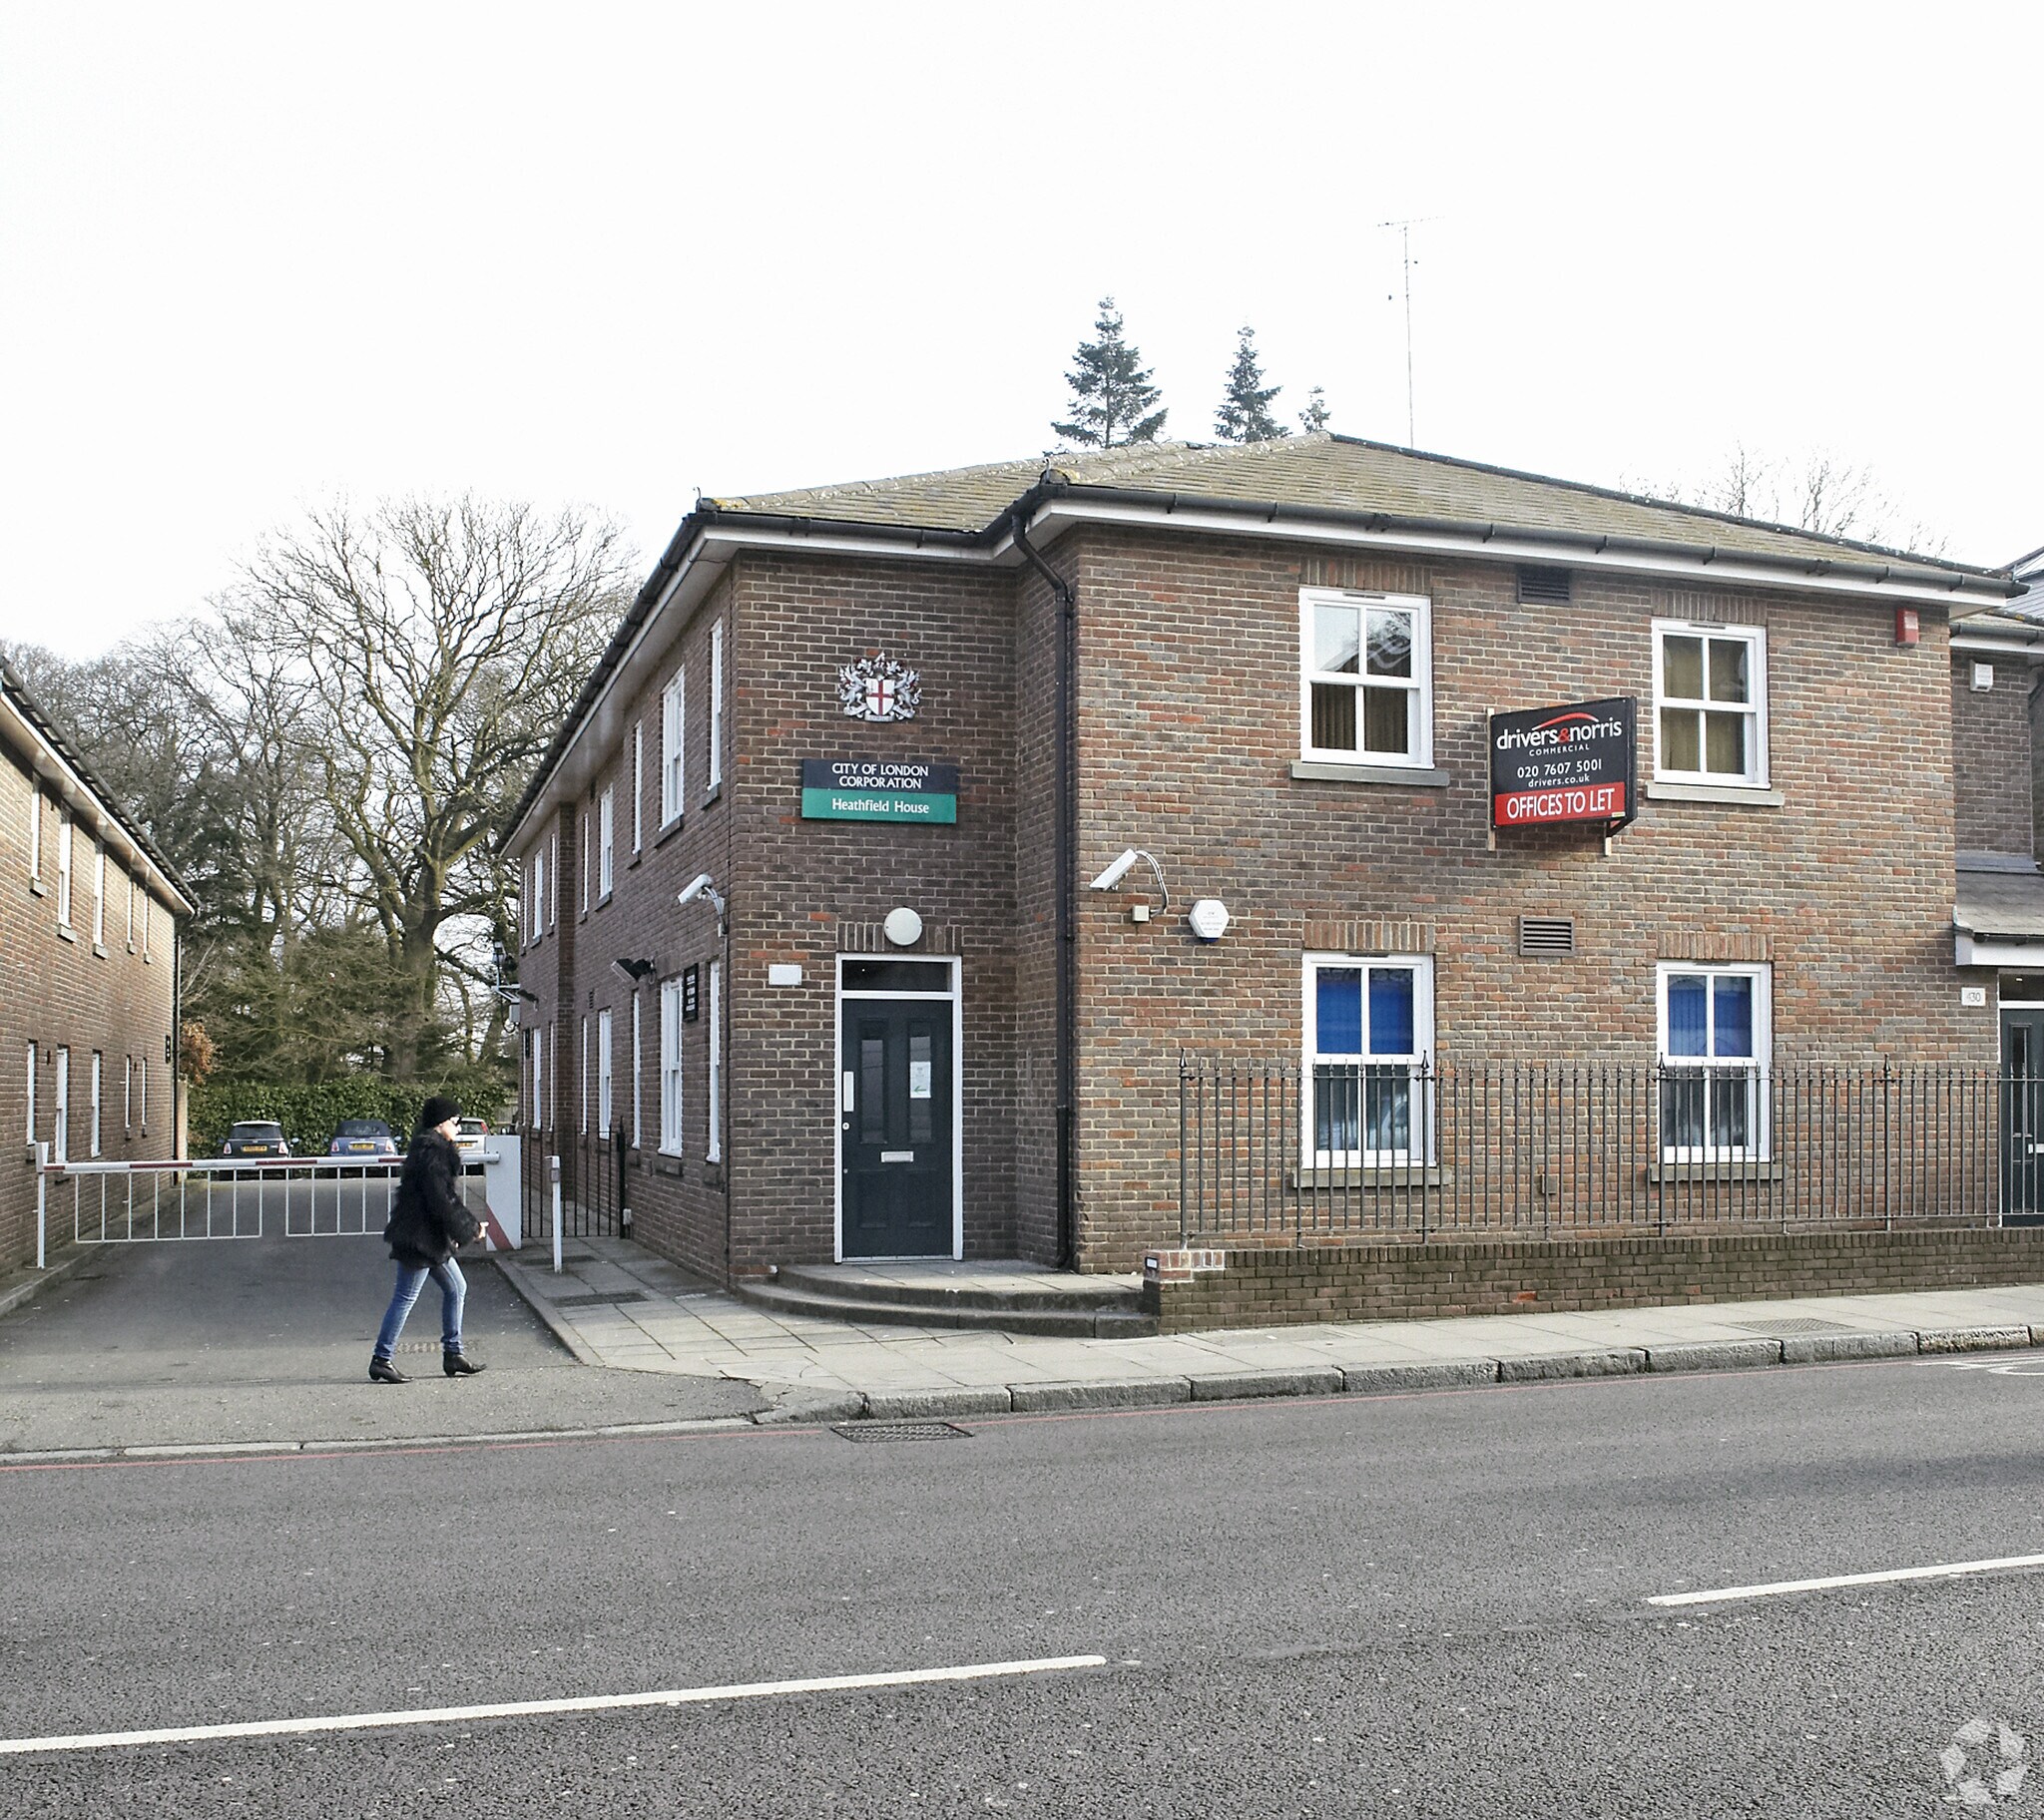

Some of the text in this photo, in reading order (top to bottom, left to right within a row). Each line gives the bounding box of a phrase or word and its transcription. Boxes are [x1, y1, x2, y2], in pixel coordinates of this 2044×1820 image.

[1529, 743, 1590, 757] COMMERCIAL
[831, 762, 929, 776] CITY OF LONDON
[1517, 758, 1602, 778] 020 7607 5001
[838, 775, 922, 789] CORPORATION
[1528, 773, 1590, 787] drivers.co.uk
[831, 798, 929, 814] Heathfield House
[1506, 788, 1615, 819] OFFICES TO LET
